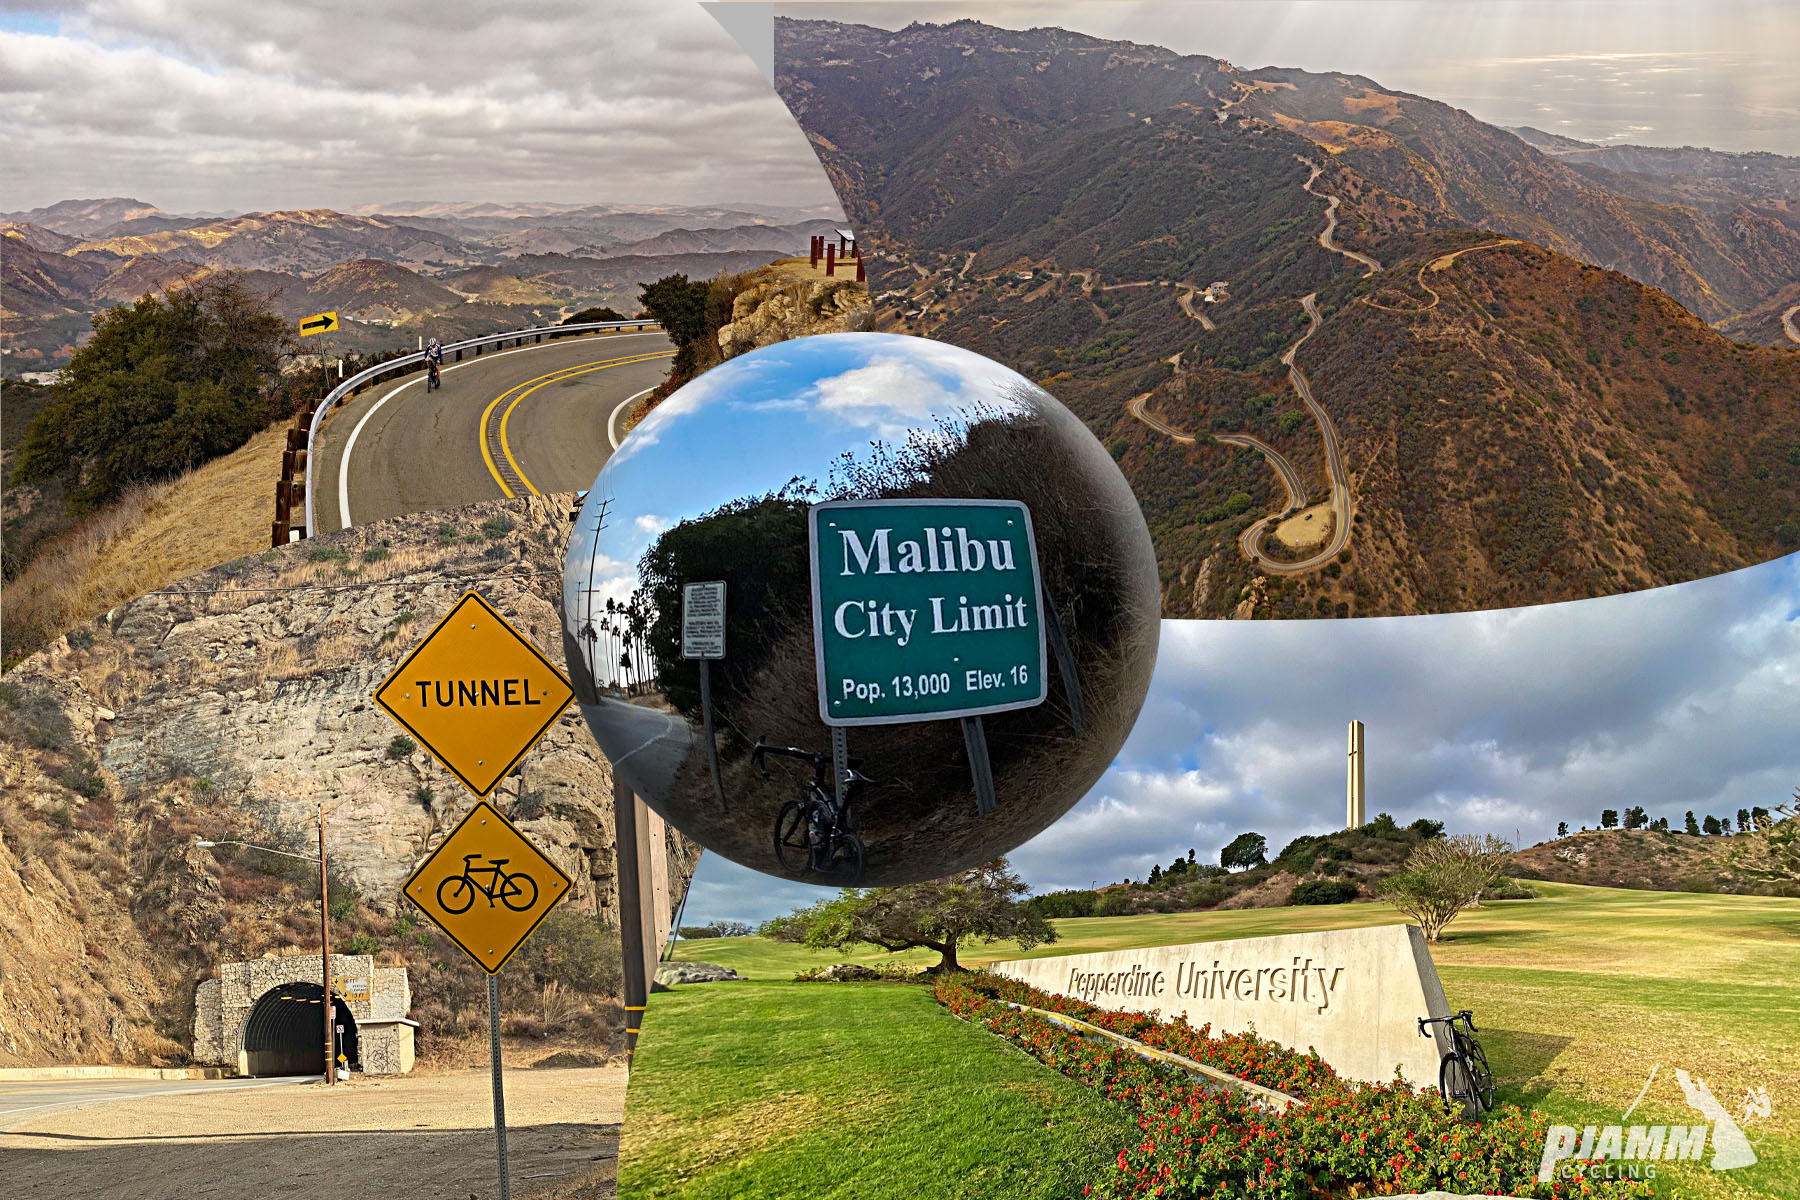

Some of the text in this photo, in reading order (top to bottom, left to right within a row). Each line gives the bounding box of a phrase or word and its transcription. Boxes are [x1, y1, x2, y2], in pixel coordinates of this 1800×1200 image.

[837, 526, 1017, 576] Malibu
[834, 593, 1029, 647] City Limit
[415, 678, 541, 708] TUNNEL
[842, 664, 1028, 704] Pop. 13,000 Elev. 16
[1067, 956, 1345, 1016] Pepperdine University
